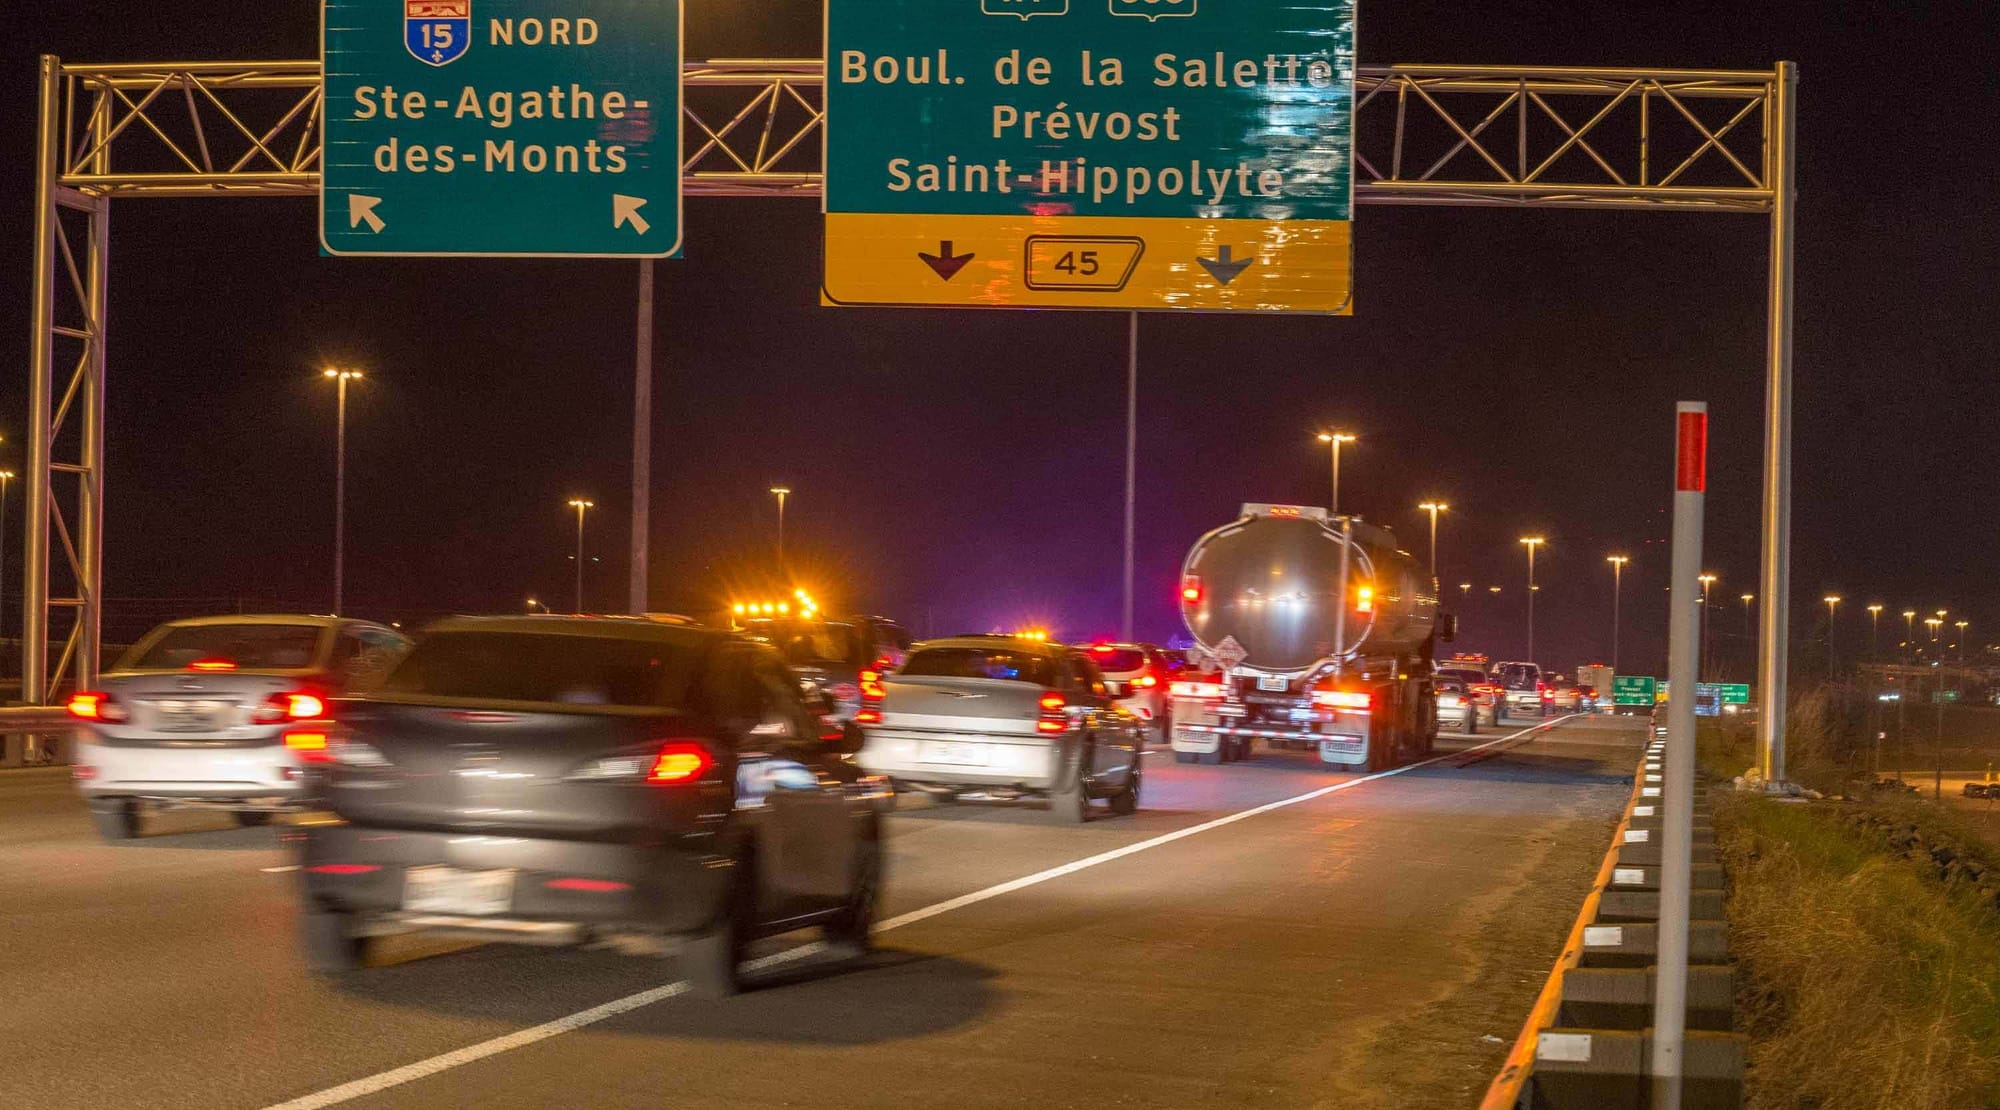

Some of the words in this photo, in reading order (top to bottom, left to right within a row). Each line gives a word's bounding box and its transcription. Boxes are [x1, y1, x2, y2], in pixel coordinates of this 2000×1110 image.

[421, 24, 453, 49] 15
[490, 18, 599, 46] NORD
[841, 49, 965, 85] Boul.
[995, 49, 1051, 86] de
[1082, 50, 1124, 86] la
[1153, 51, 1332, 88] Salette
[354, 84, 649, 128] Ste-Agathe-
[992, 102, 1181, 141] Prévost
[374, 137, 627, 173] des-Monts
[887, 155, 1283, 205] Saint-Hippolyte
[1055, 251, 1099, 276] 45
